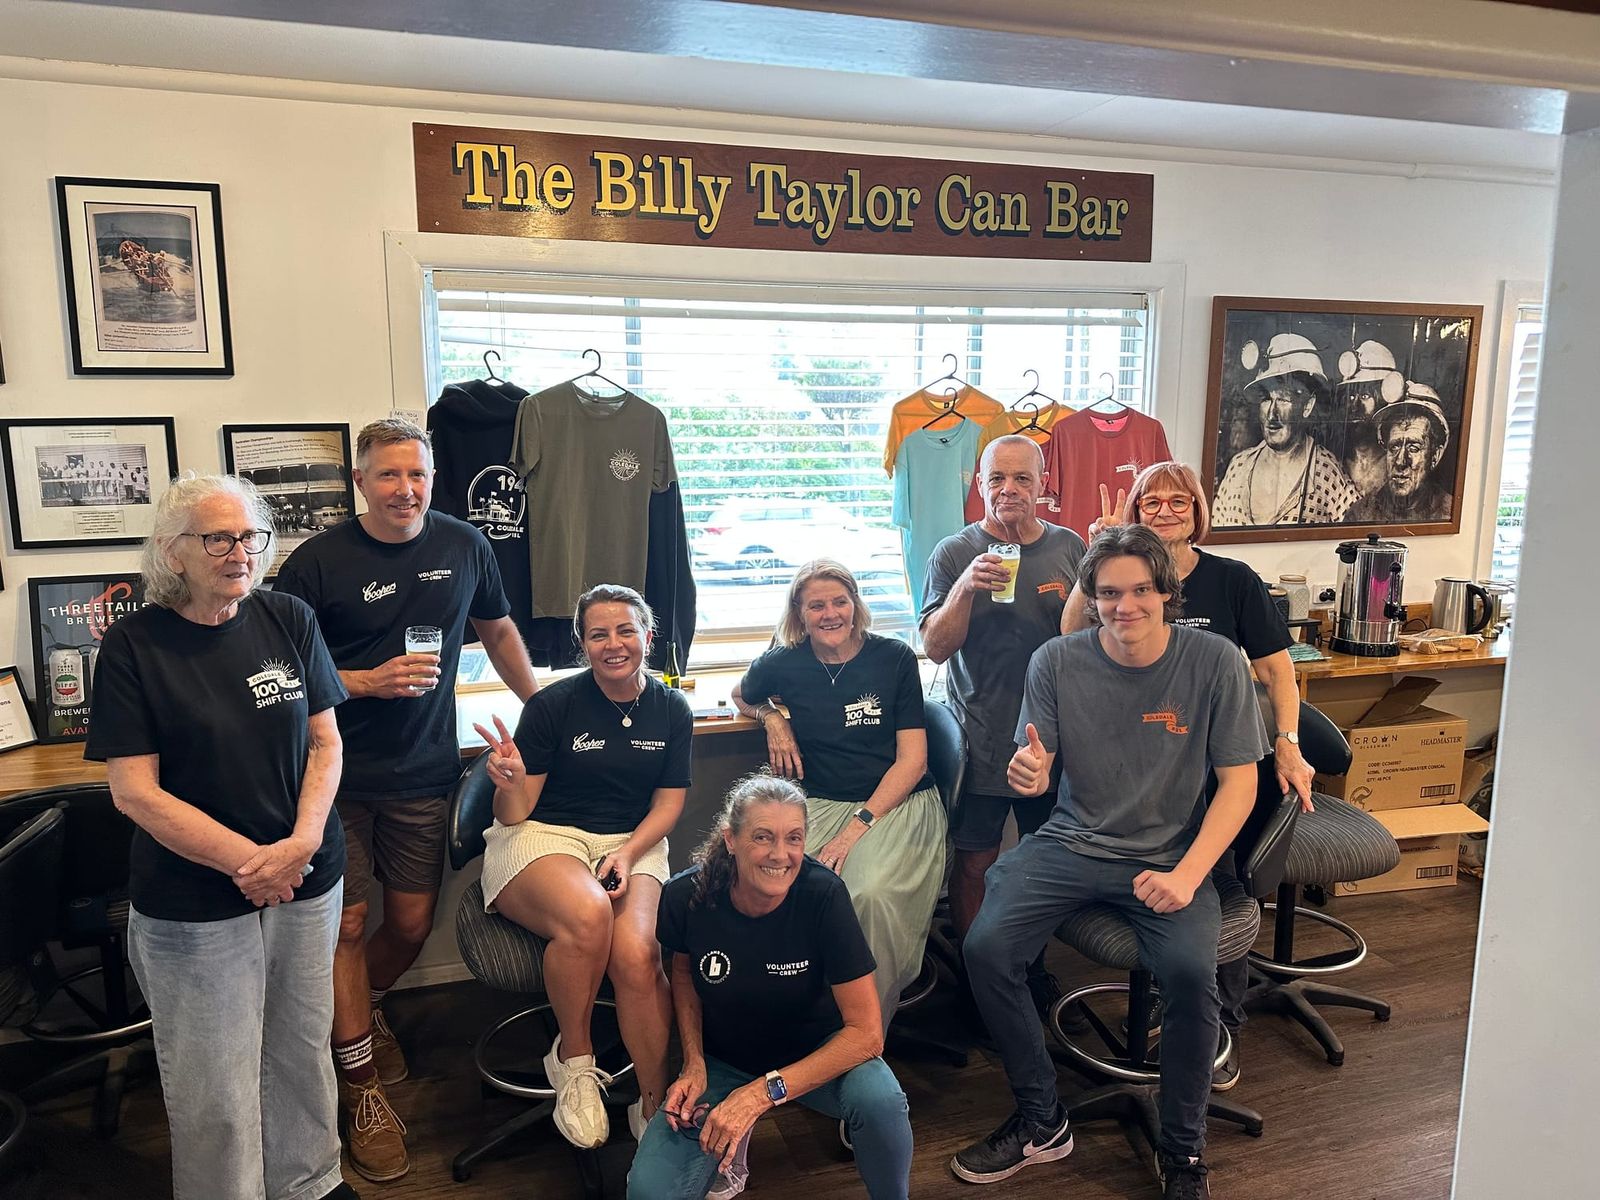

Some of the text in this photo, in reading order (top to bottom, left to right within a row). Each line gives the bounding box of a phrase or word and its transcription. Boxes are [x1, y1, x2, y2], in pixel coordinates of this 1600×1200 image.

[455, 141, 1130, 241] The Billy Taylor Can Bar
[497, 474, 527, 493] 194
[418, 569, 452, 579] VOLUNTEER
[48, 603, 102, 617] THREE
[66, 614, 124, 625] BREWE
[252, 671, 281, 683] COLEDALE
[252, 682, 279, 699] 100
[256, 690, 304, 709] SHIFT CLUB
[54, 707, 91, 717] BREWE
[845, 710, 863, 721] 100
[630, 739, 666, 747] VOLUNTEER
[1354, 734, 1398, 745] CROWN
[1420, 736, 1462, 746] HEADMASTER
[766, 960, 809, 971] VOLUNTEER
